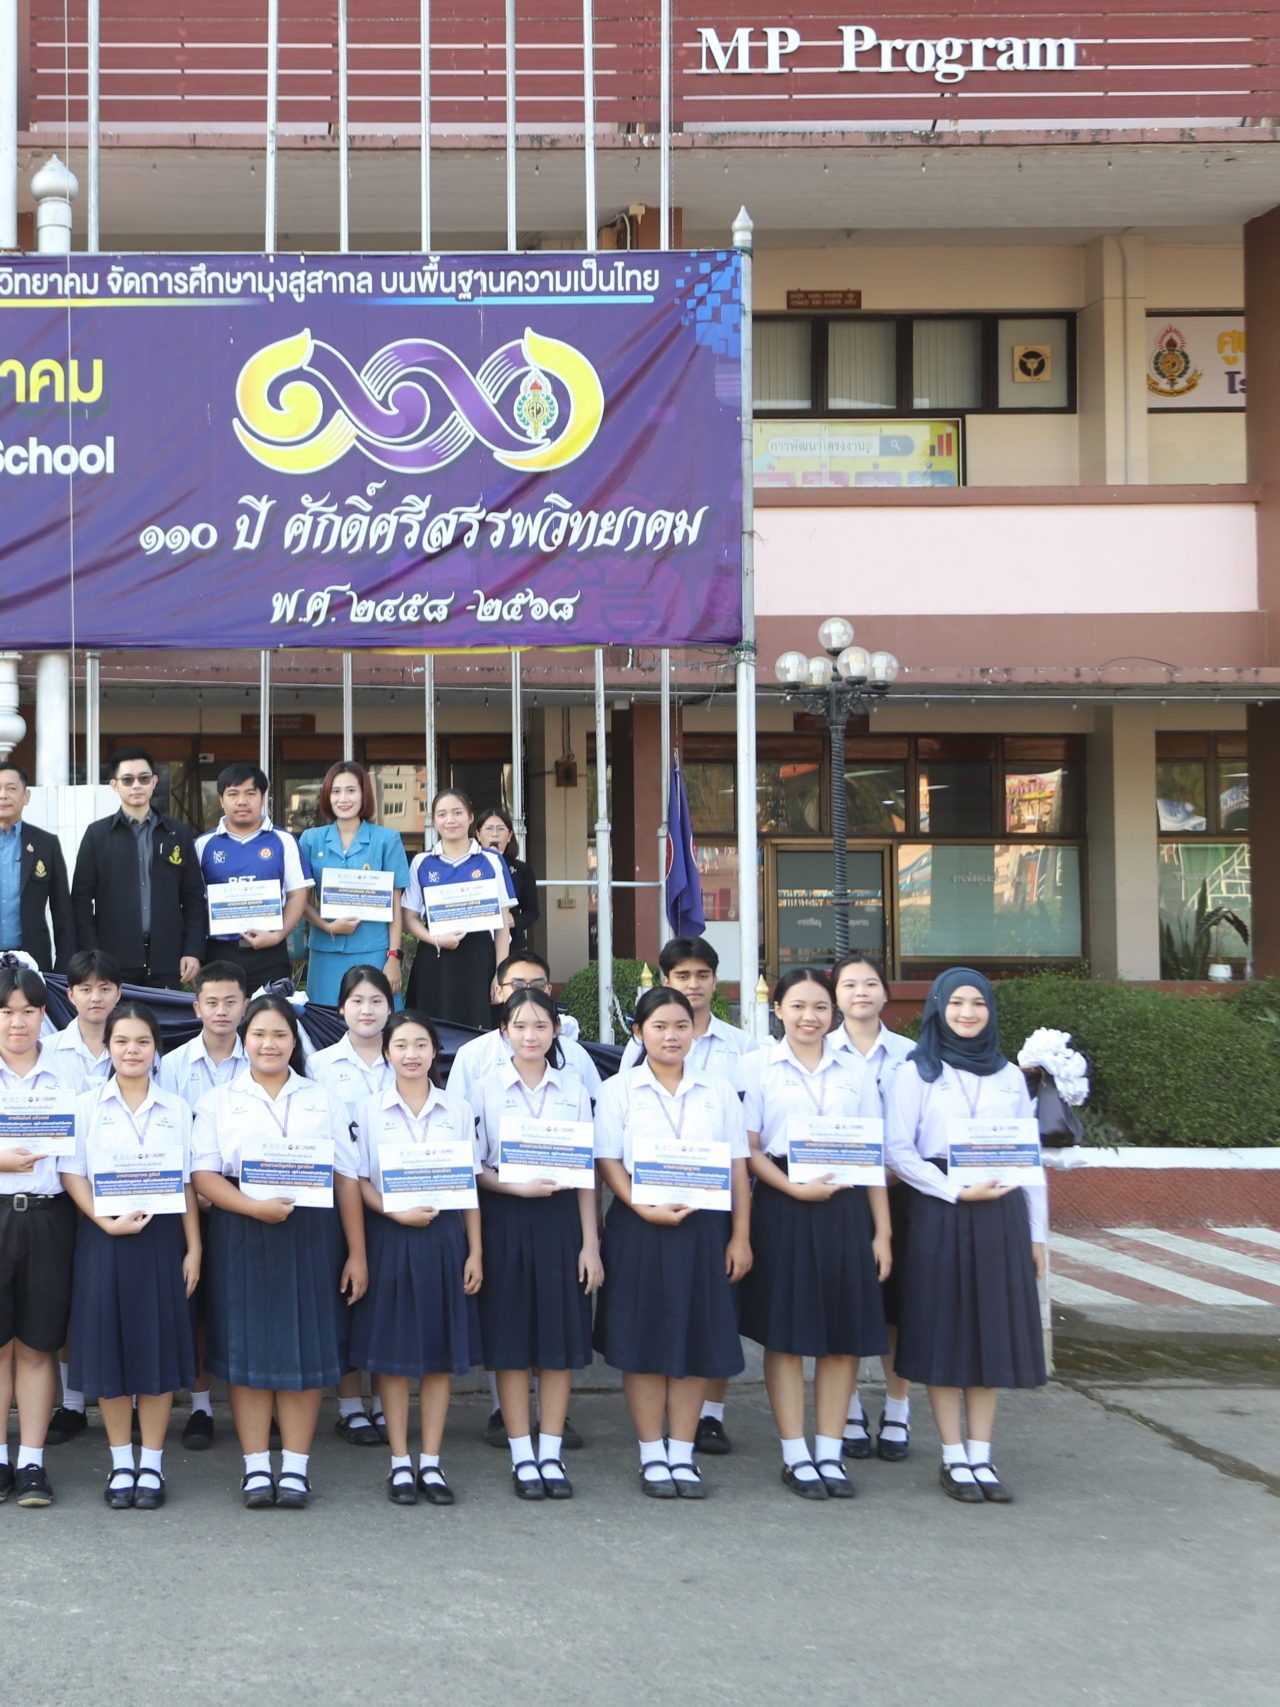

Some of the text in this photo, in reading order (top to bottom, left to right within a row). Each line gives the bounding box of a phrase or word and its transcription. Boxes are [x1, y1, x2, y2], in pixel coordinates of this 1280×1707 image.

[697, 25, 1078, 83] MP Program
[107, 257, 373, 303] จัดการศึกษามุ่งสู่สากล
[381, 256, 660, 300] บนพื้นฐานความเป็นไทย
[140, 479, 709, 556] ๑๑๐ ปี ศักดิ์ศรีสรรพวิทยาคม
[346, 591, 455, 622] ๒๔๕๘
